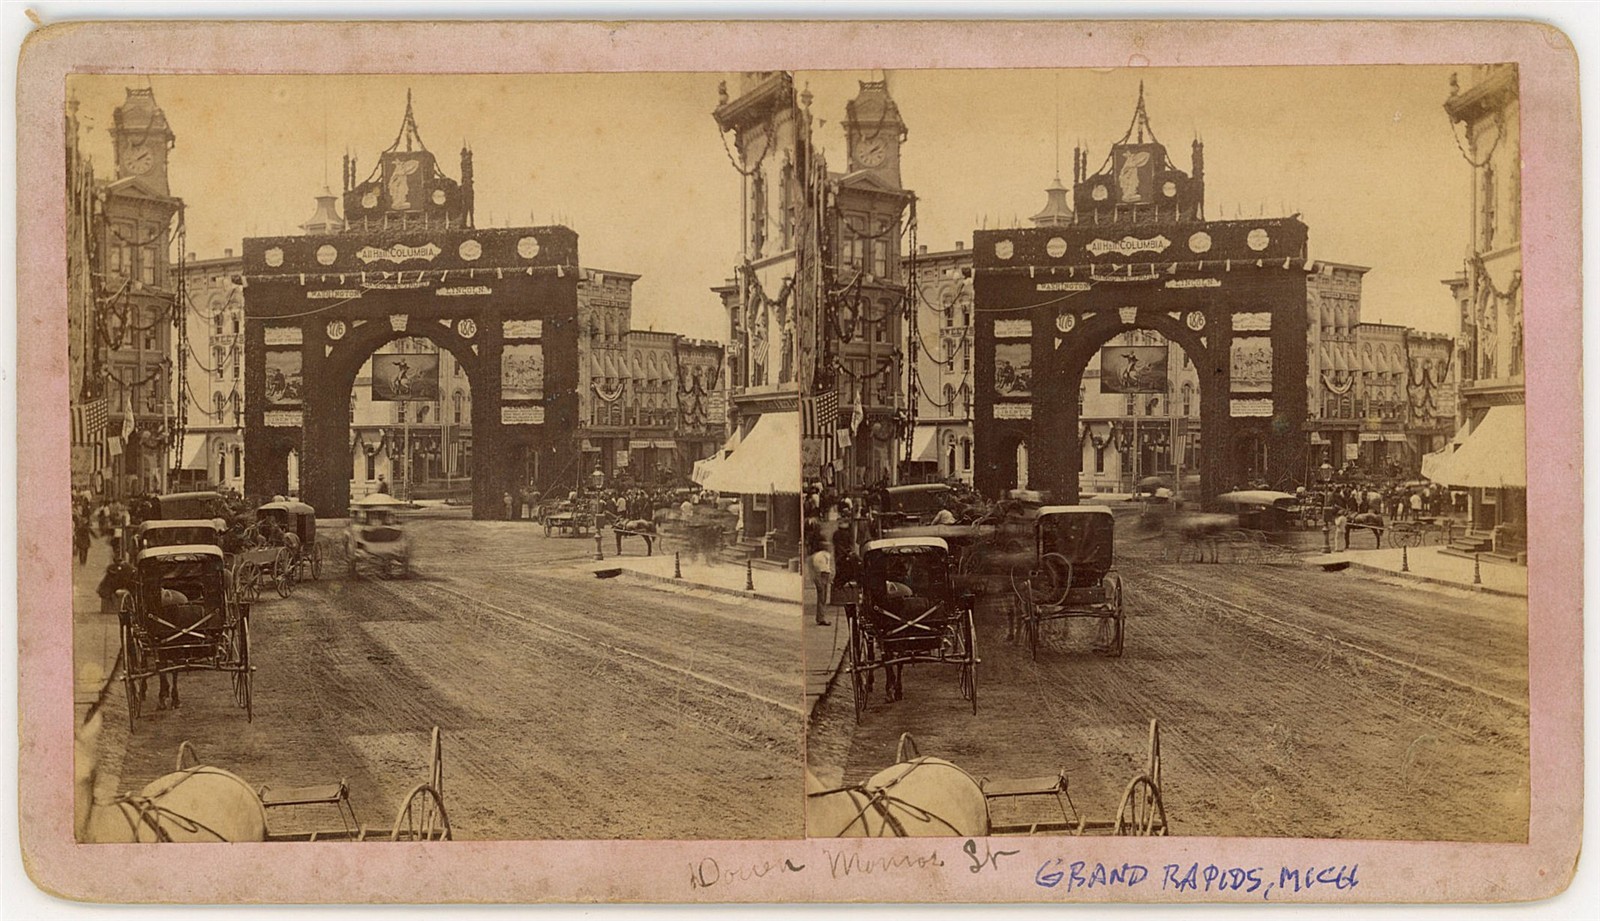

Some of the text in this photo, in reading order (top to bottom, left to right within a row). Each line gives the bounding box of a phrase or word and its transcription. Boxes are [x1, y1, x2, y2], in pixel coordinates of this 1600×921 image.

[390, 247, 434, 258] COLUMBIA
[1120, 240, 1164, 250] COLUMBIA
[310, 290, 360, 298] WASHNGTON
[1040, 282, 1090, 290] WASHNGTON
[327, 320, 345, 338] 1776
[459, 320, 475, 337] 1876
[1056, 313, 1074, 331] 1776
[1188, 312, 1204, 329] 1876
[1035, 858, 1148, 893] GRAND
